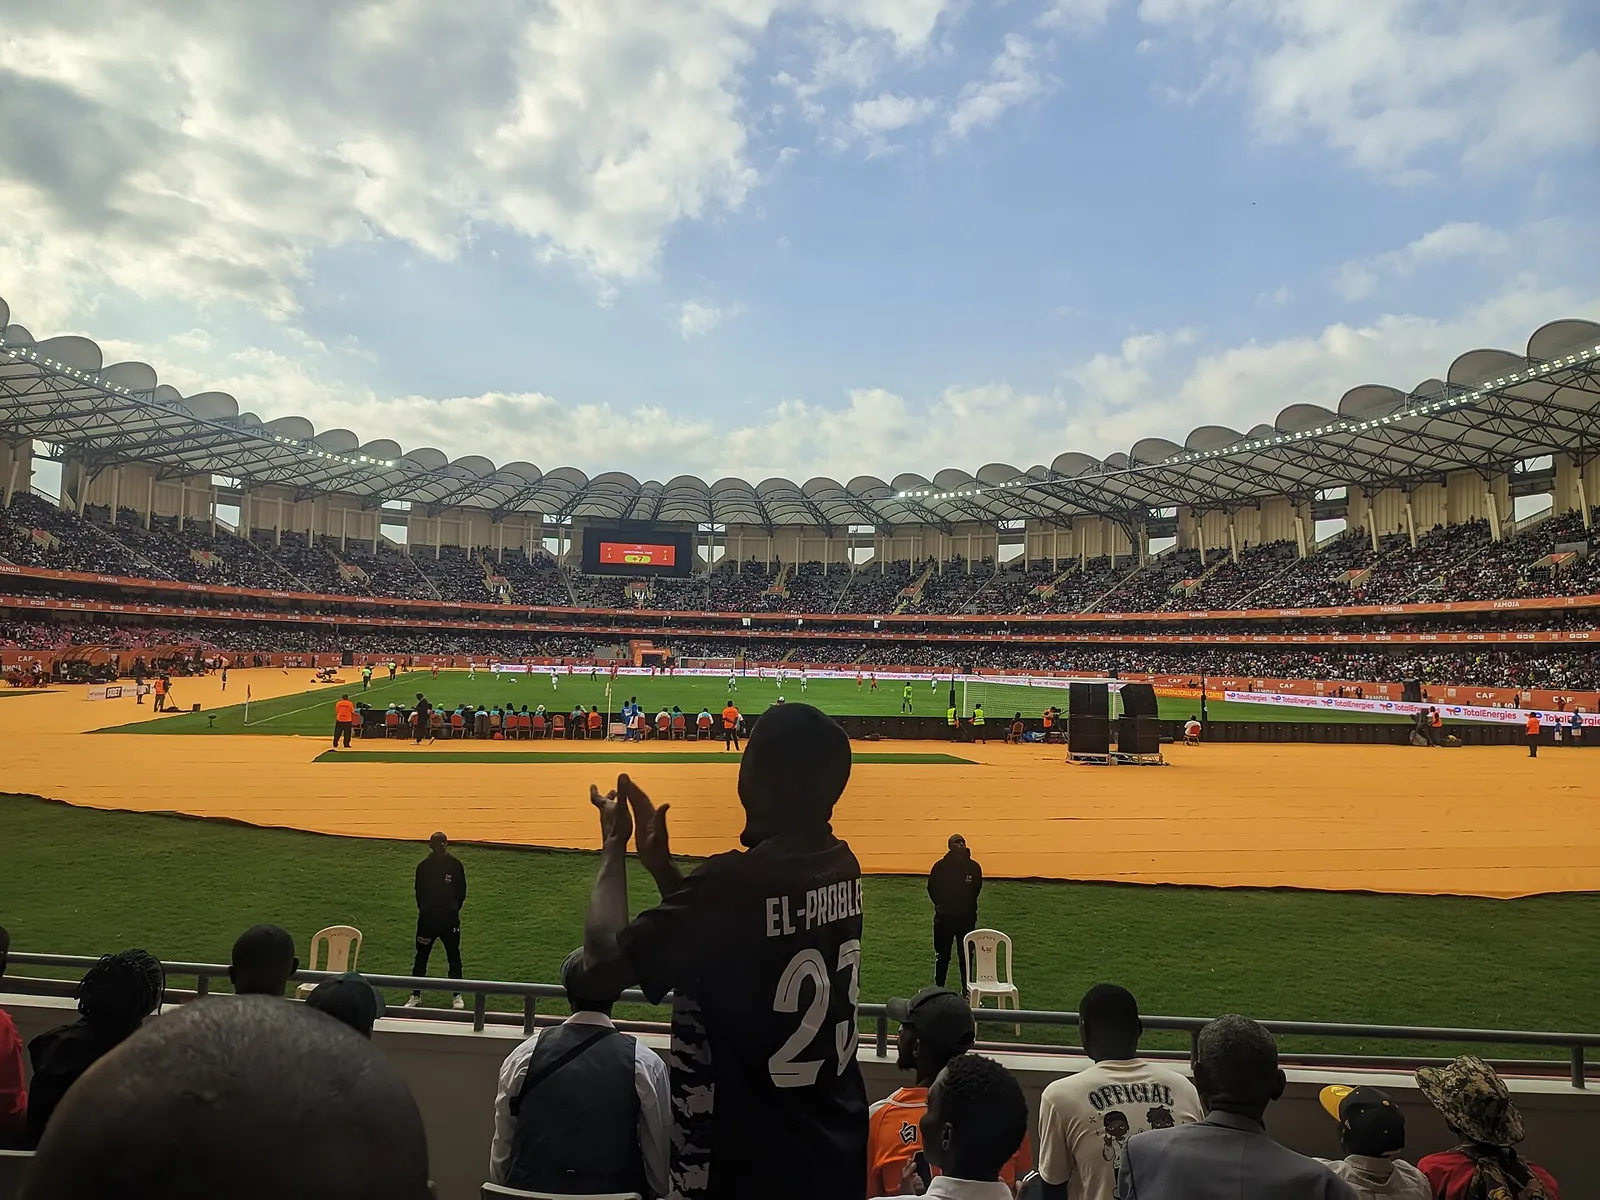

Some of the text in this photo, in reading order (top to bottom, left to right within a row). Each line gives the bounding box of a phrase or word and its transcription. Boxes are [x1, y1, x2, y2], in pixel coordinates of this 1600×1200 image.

[1237, 693, 1266, 702] TotalEnergies
[1282, 696, 1317, 705] TotalEnergies
[1334, 700, 1374, 709] TotalEnergies
[1463, 708, 1517, 720] TotalEnergies
[768, 939, 861, 1088] 23
[1088, 1082, 1174, 1111] OFFICIAL
